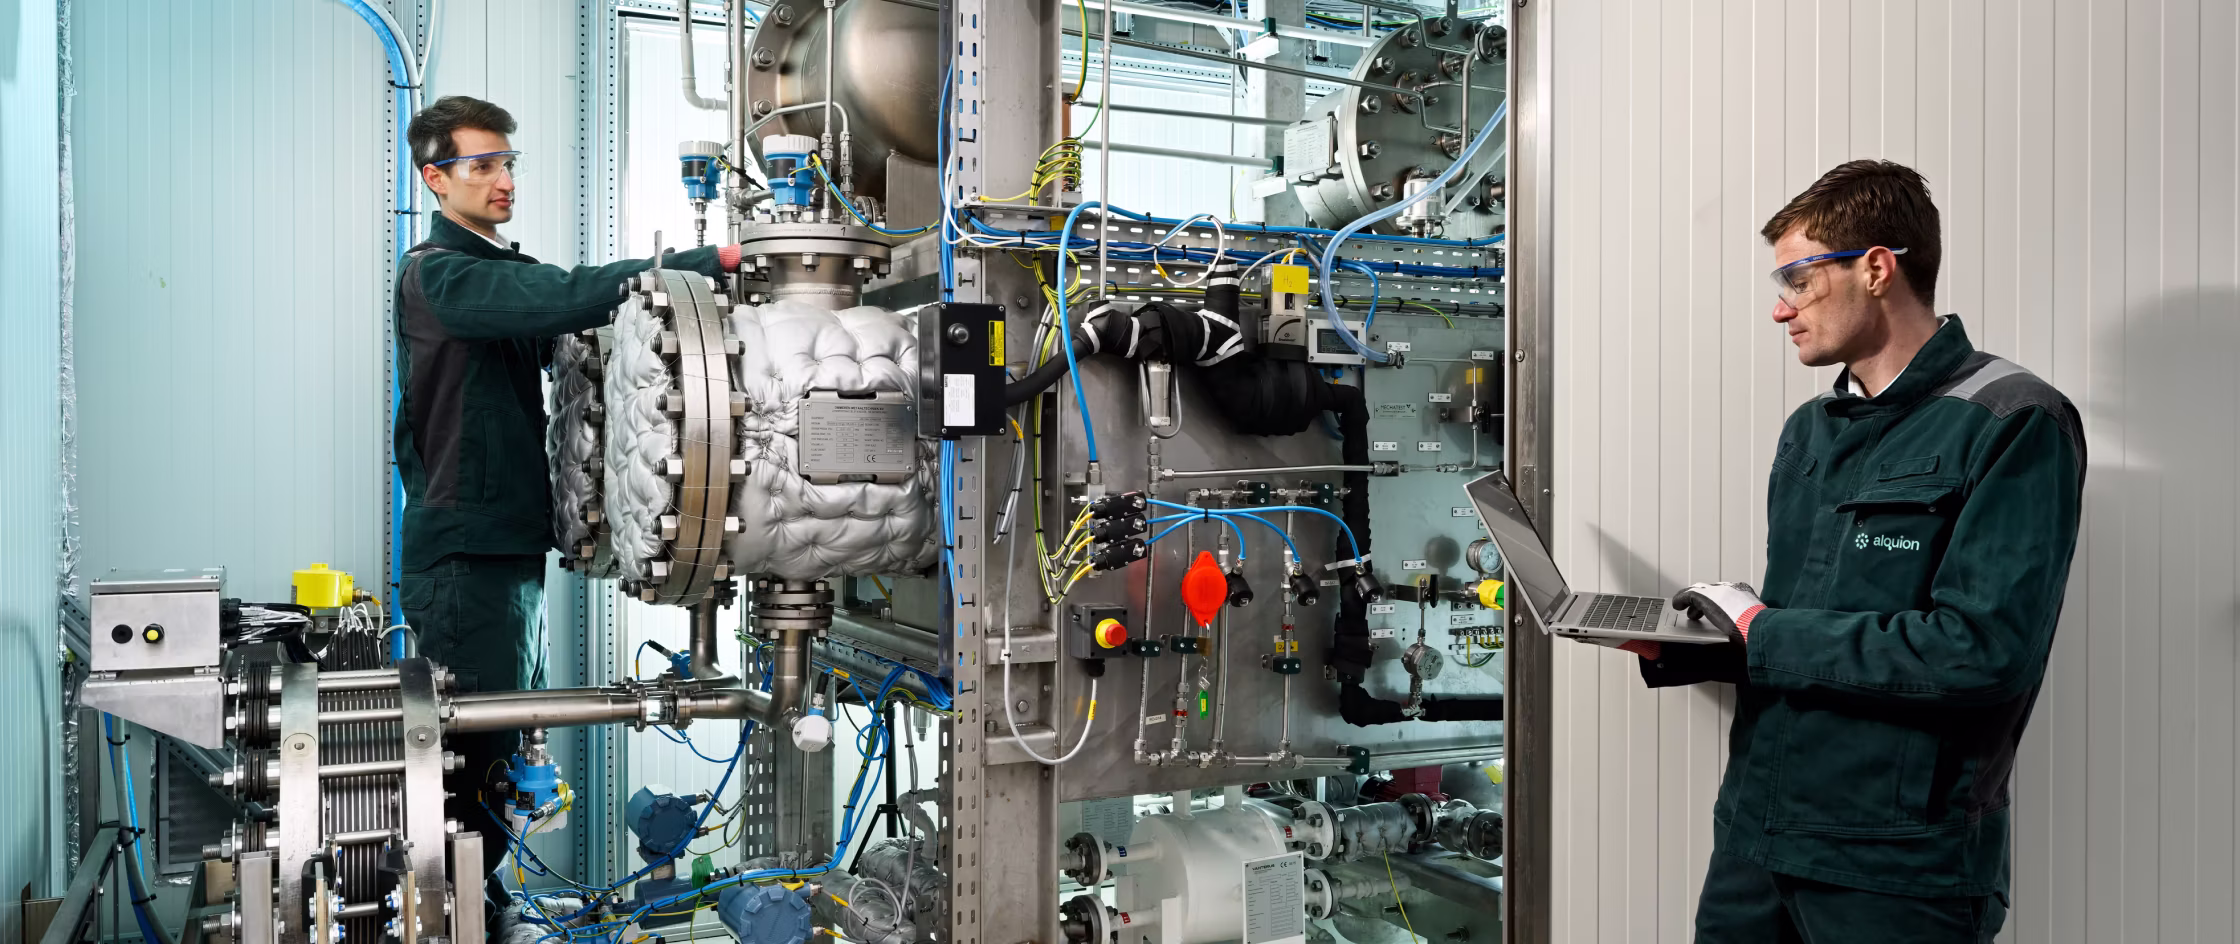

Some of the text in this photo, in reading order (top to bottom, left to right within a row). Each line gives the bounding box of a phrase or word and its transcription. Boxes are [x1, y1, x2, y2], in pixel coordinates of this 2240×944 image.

[1429, 135, 1437, 145] 2
[840, 226, 846, 236] 1
[1873, 534, 1920, 551] alquion
